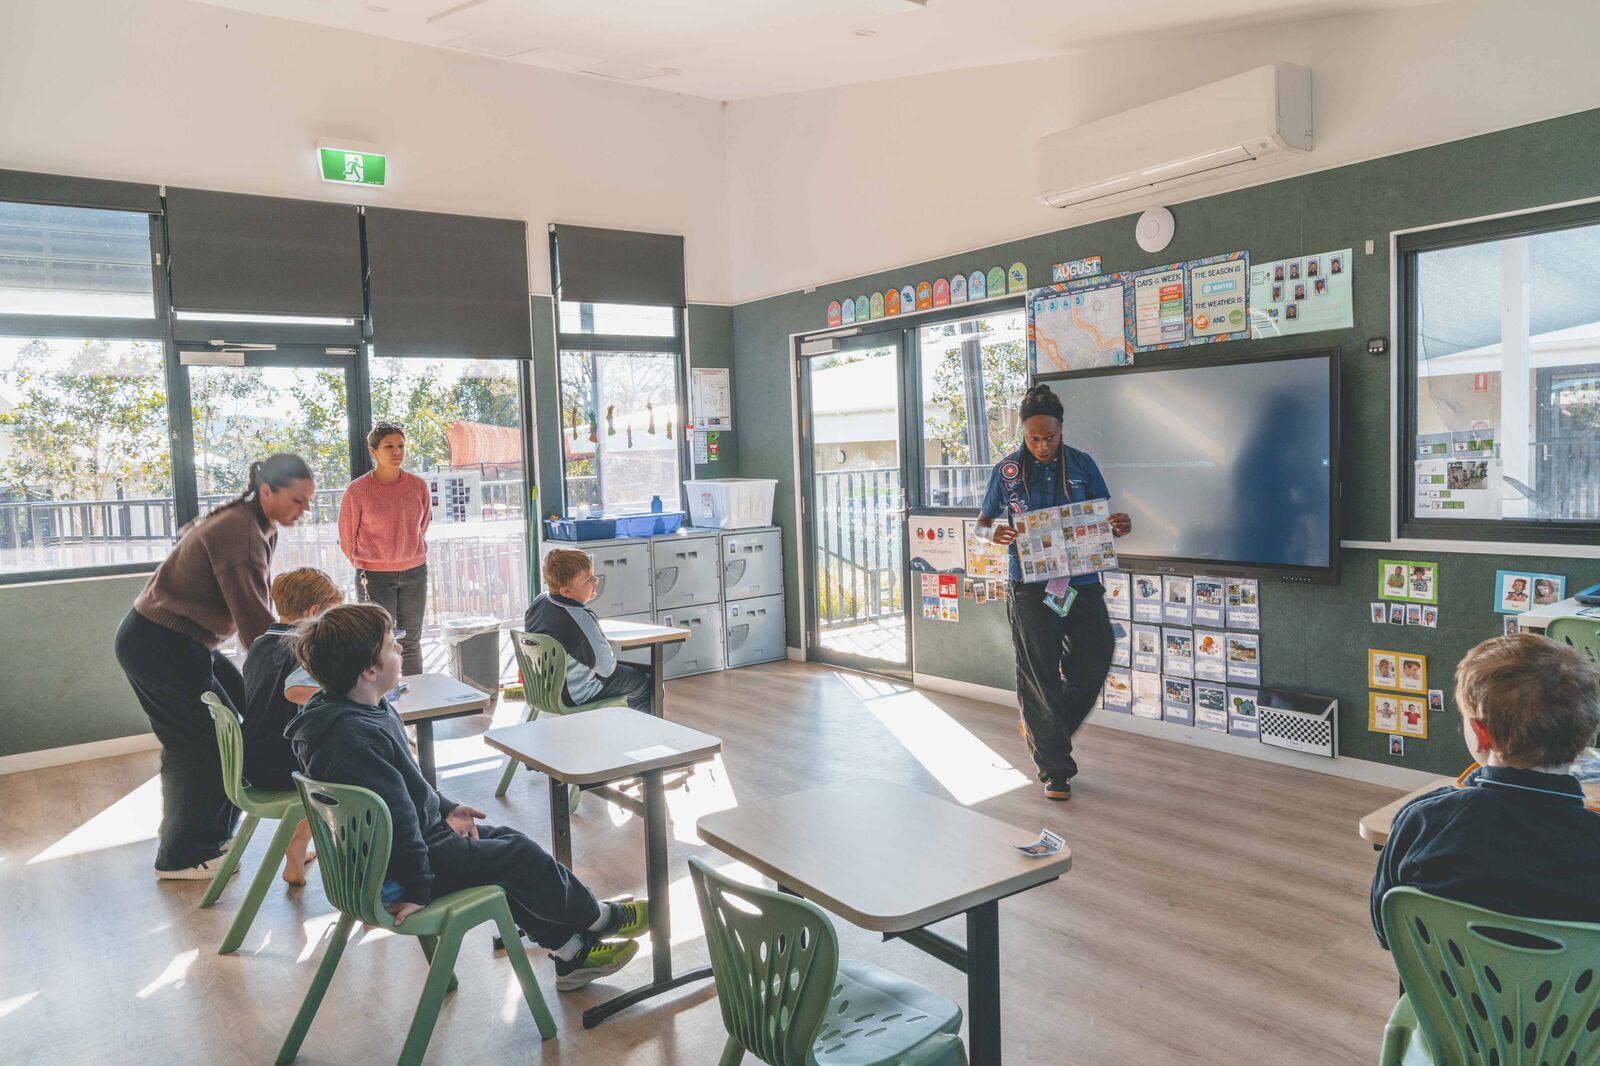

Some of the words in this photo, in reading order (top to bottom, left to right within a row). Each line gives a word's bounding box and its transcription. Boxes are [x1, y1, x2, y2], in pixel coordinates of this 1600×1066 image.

[1055, 260, 1099, 279] AUGUST
[1208, 267, 1233, 276] SEASON
[1137, 279, 1153, 288] DAYS
[1161, 273, 1181, 283] WEEK
[1208, 298, 1235, 308] WEATHER
[1213, 316, 1226, 324] AND
